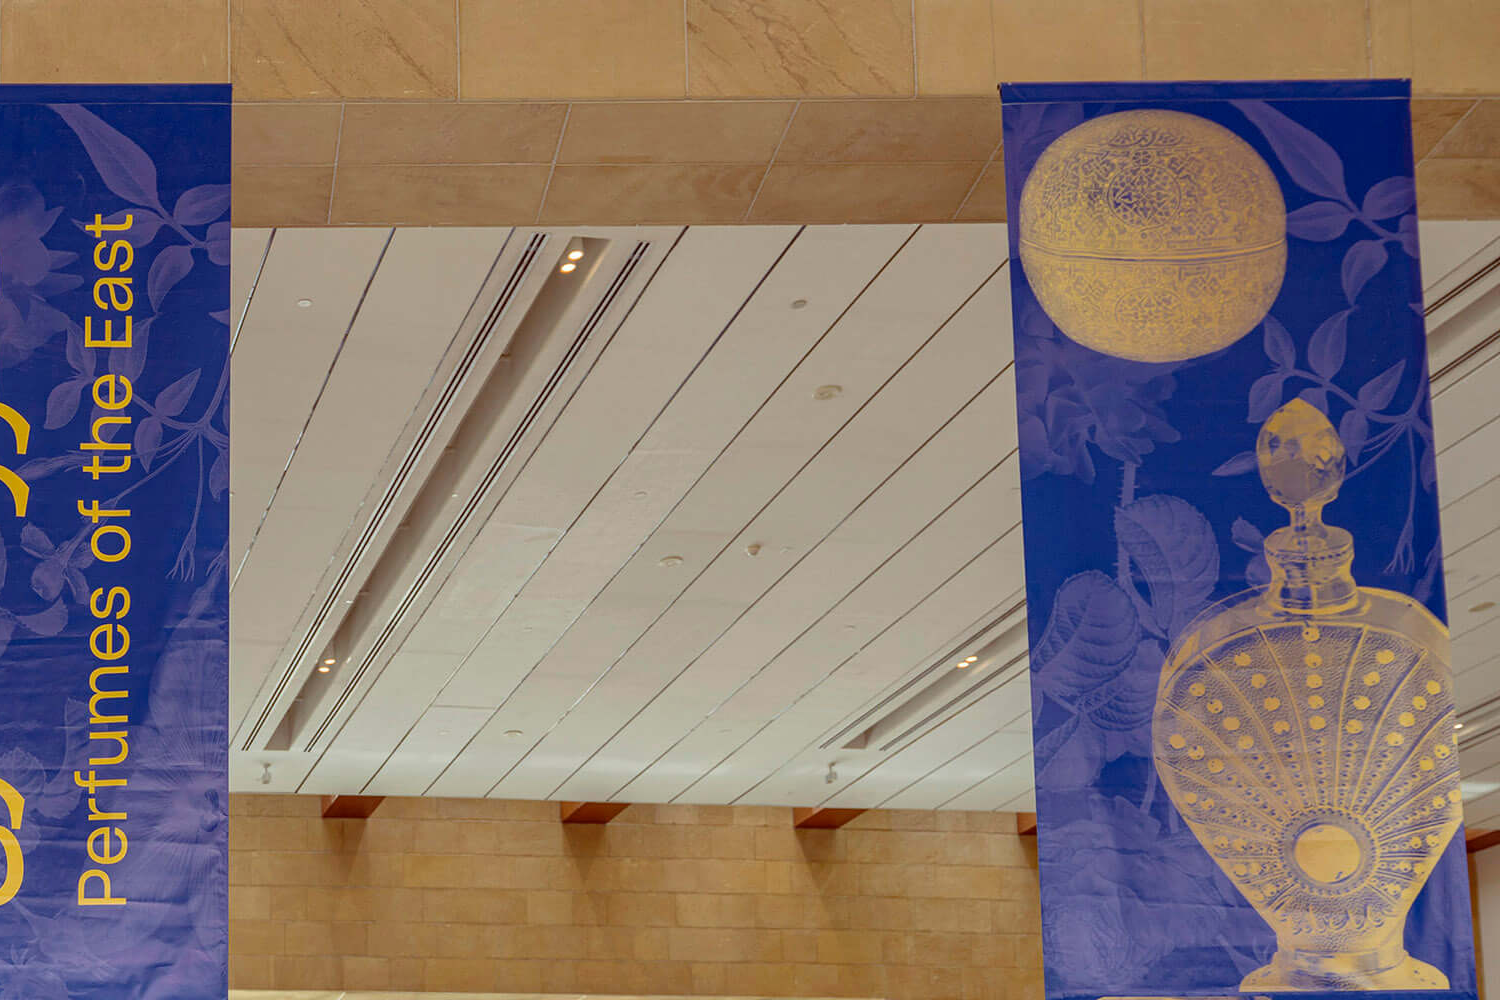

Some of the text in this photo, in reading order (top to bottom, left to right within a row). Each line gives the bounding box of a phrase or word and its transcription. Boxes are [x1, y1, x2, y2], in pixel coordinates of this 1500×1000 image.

[74, 213, 133, 907] Perfumes of the East
